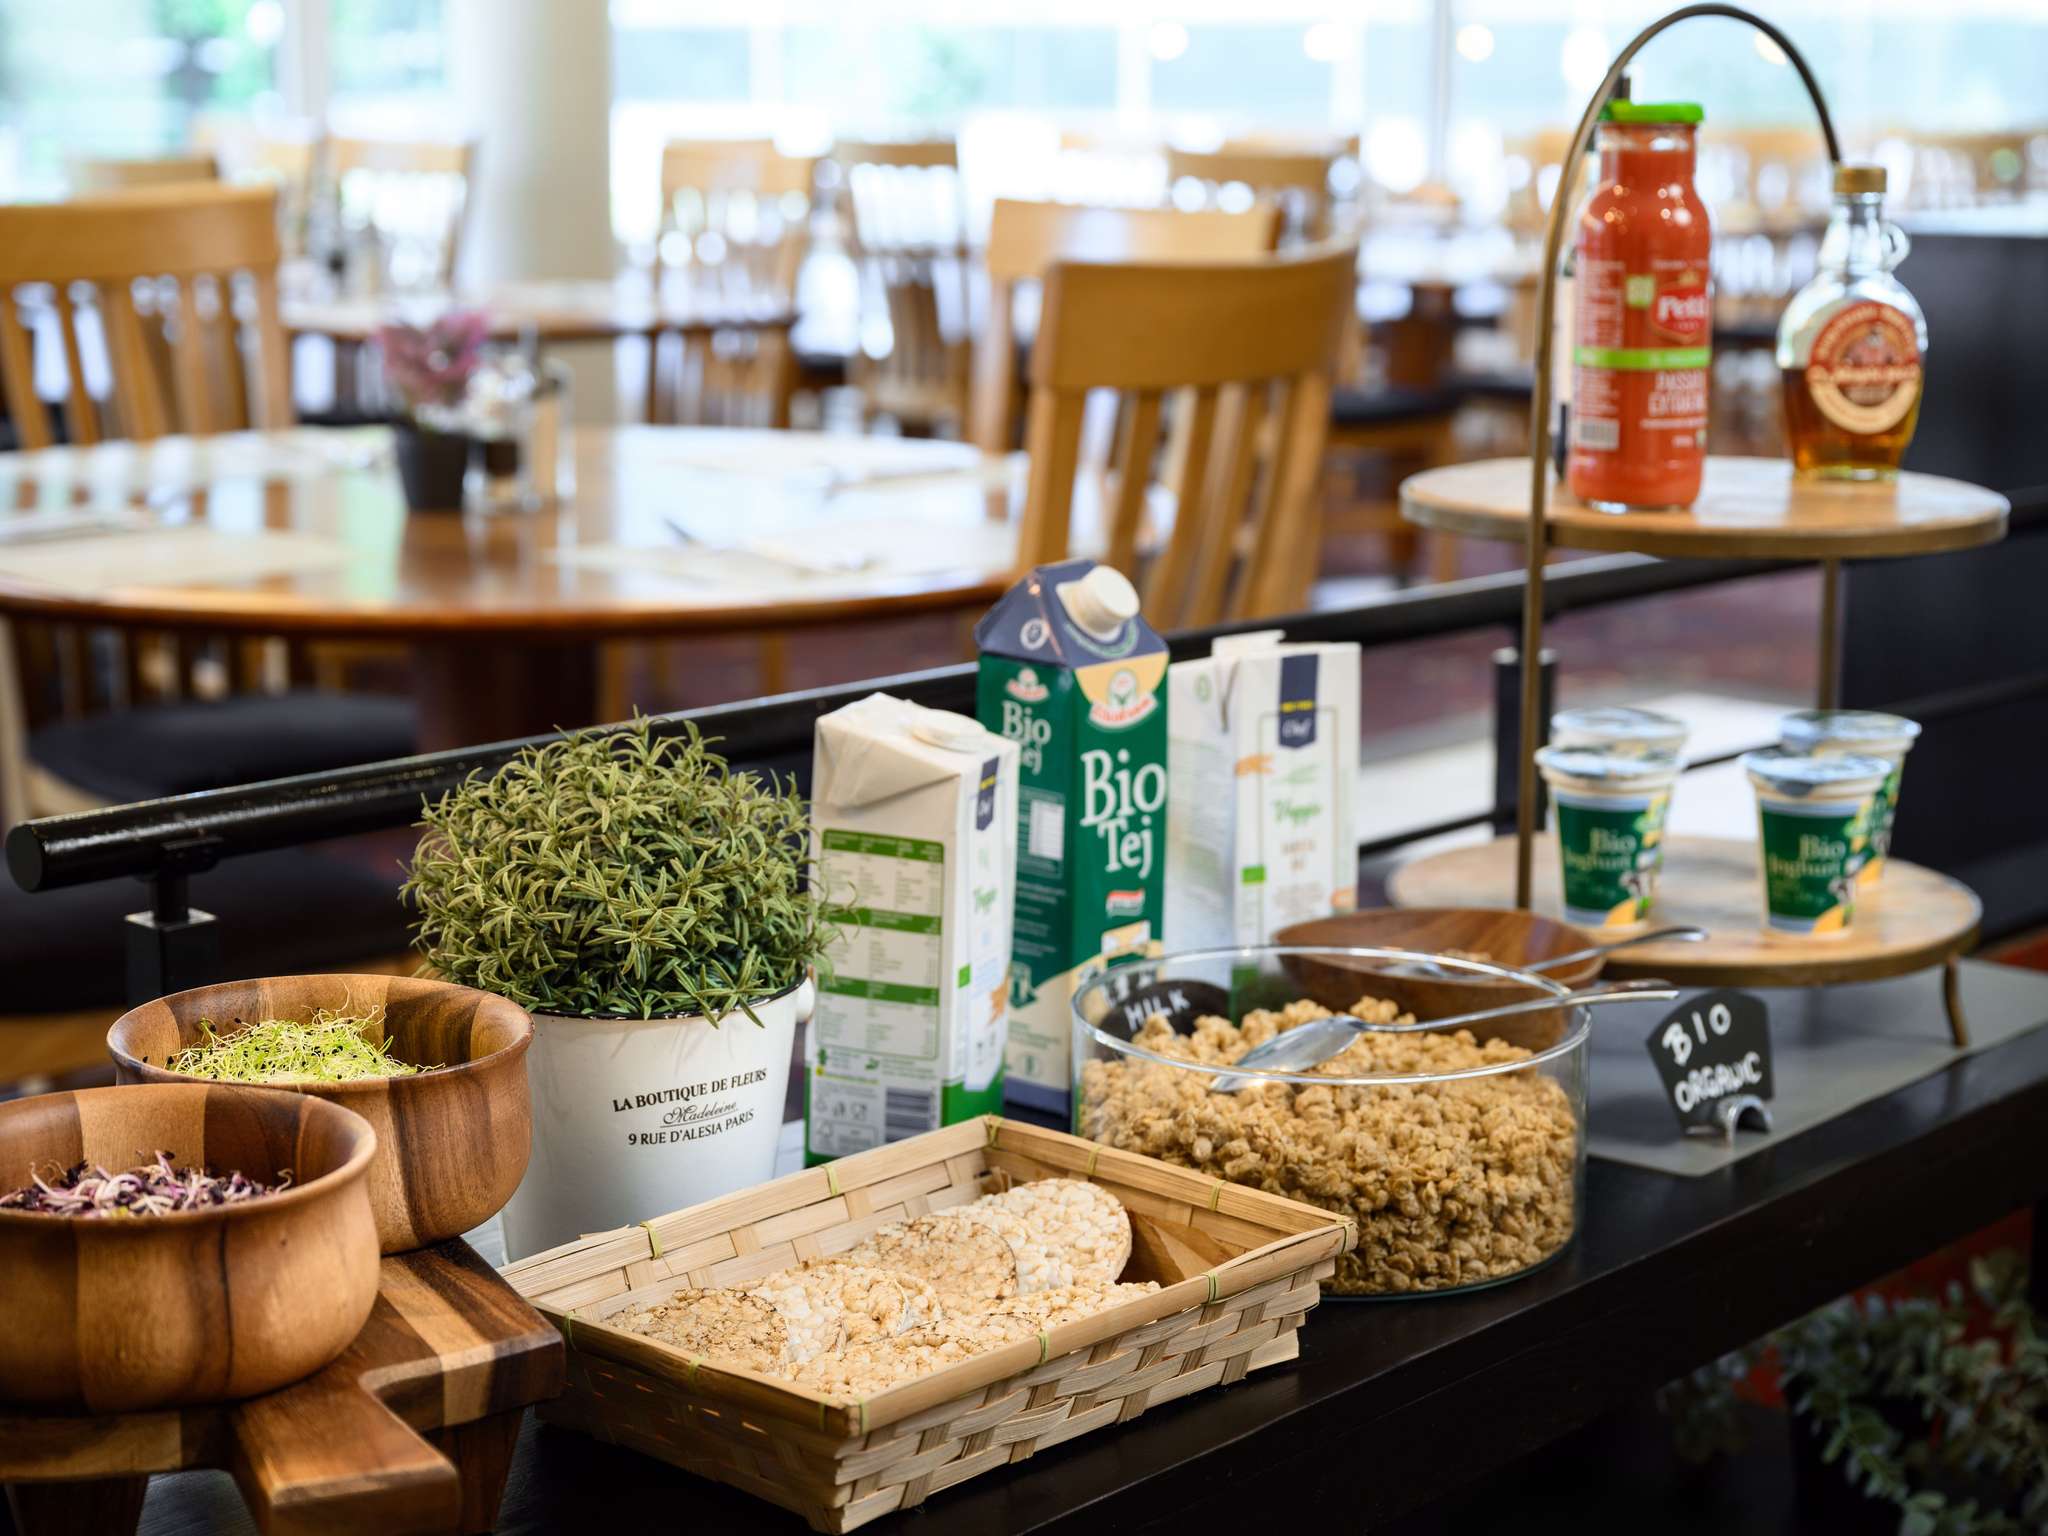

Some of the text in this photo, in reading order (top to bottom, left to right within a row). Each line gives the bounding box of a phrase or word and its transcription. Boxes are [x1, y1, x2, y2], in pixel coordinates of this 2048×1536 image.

[1002, 700, 1051, 745] Bio
[1081, 749, 1166, 826] Bio
[1098, 815, 1153, 879] Tej
[1589, 828, 1637, 853] Bio
[1800, 834, 1846, 858] Bio
[1124, 988, 1191, 1032] MILK
[1661, 1002, 1732, 1067] BIO
[612, 1068, 768, 1112] LA BOUTIQUE DE FLEURS
[628, 1109, 755, 1146] 9 RUE D'ALESIA PARIS
[662, 1101, 738, 1125] Madeleine
